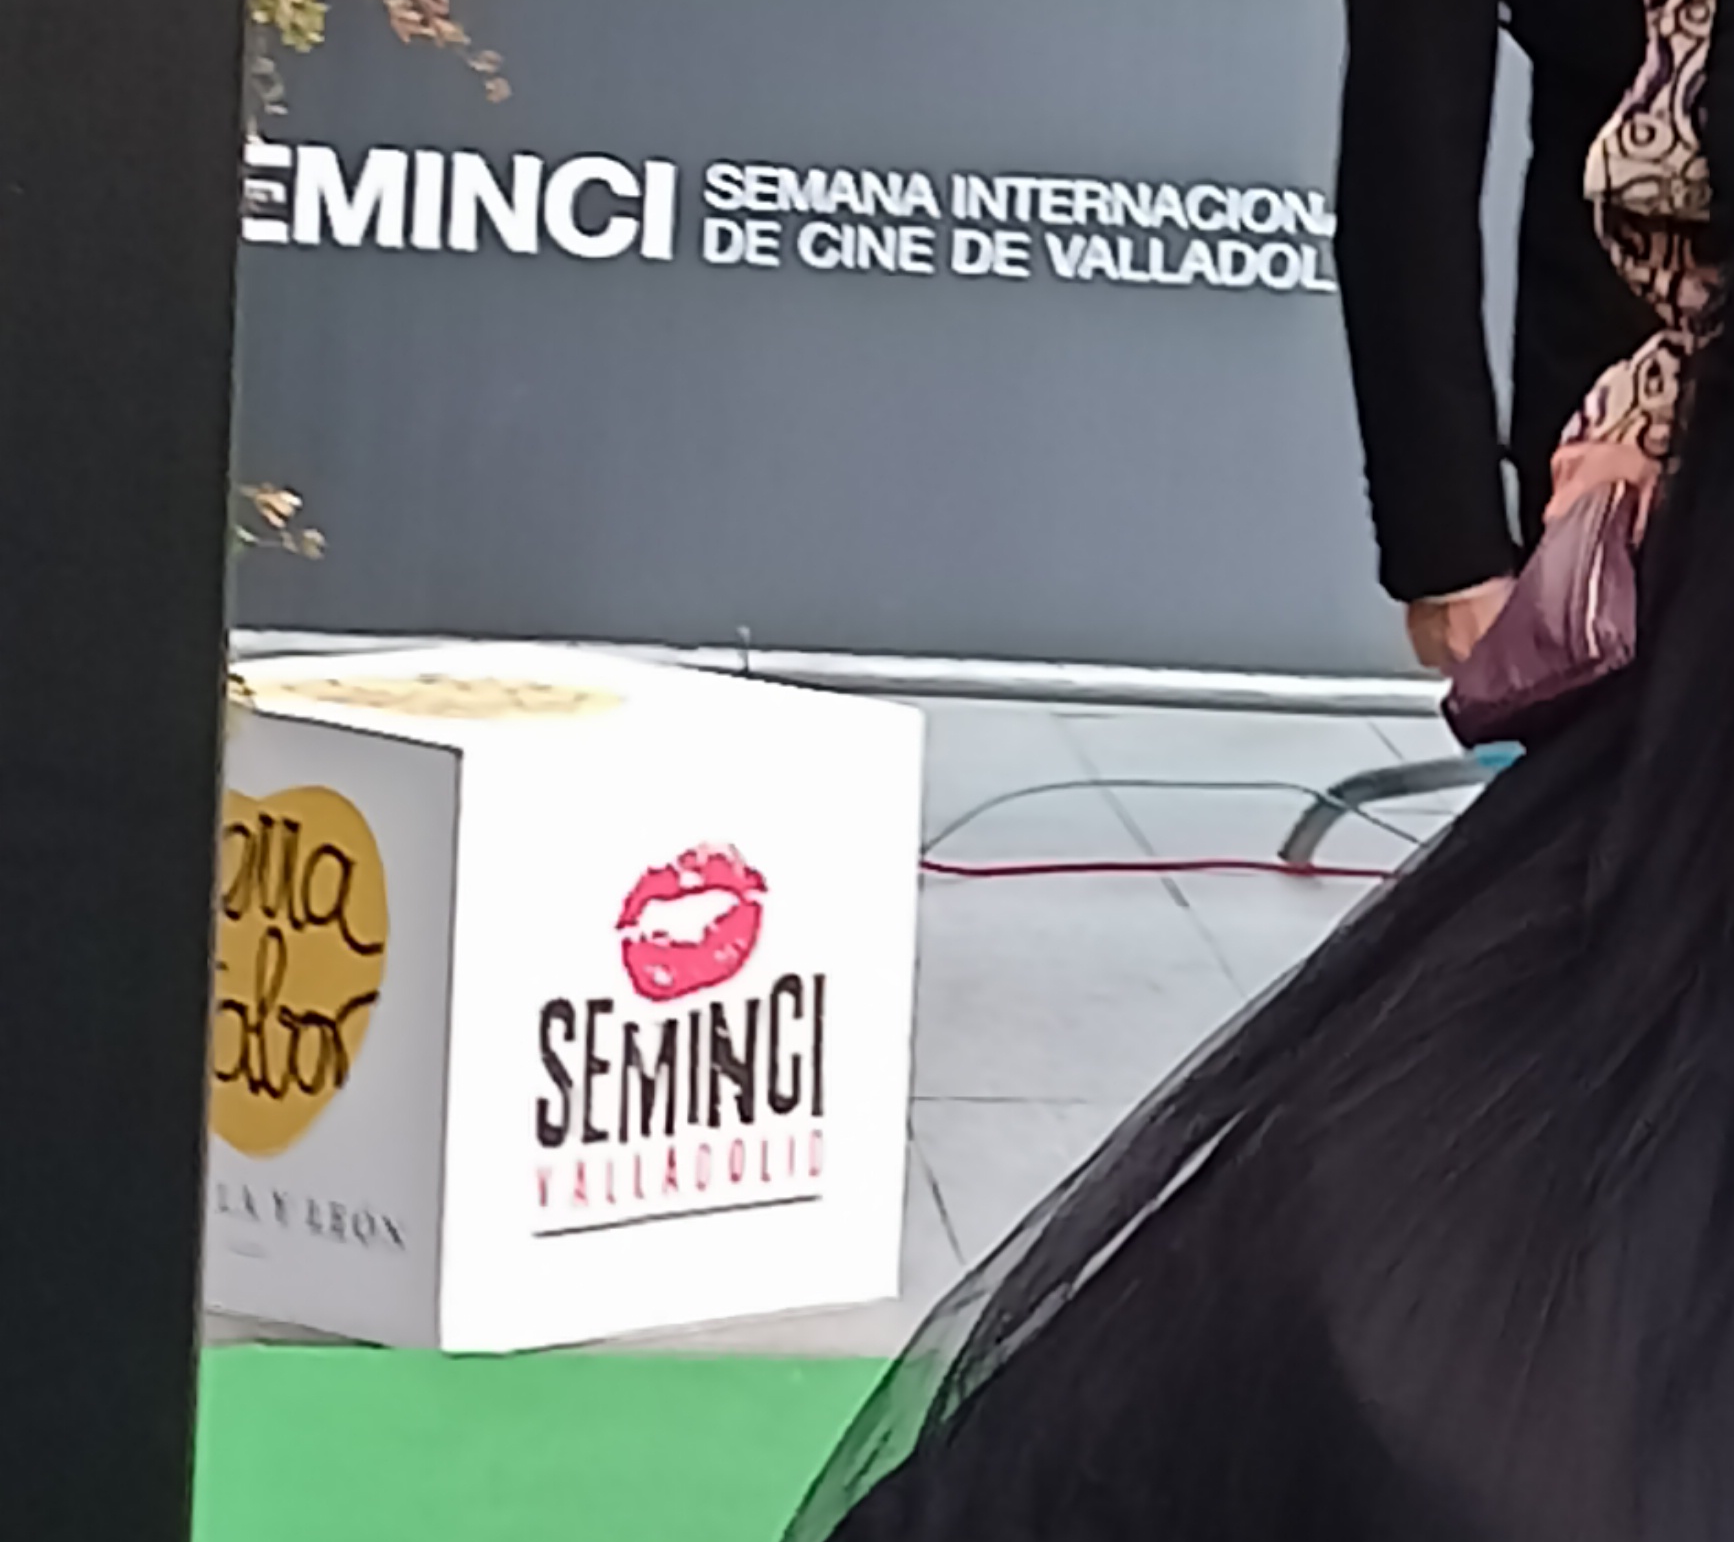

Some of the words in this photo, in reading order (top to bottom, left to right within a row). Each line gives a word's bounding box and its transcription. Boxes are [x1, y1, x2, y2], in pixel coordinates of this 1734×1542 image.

[703, 163, 941, 219] SEMANA
[951, 174, 1337, 238] INTERNACION
[702, 217, 783, 267] DE
[797, 222, 936, 274] CINE
[951, 227, 1032, 278] DE
[537, 973, 826, 1149] SEMINCI
[537, 1129, 824, 1208] VALLADOLID
